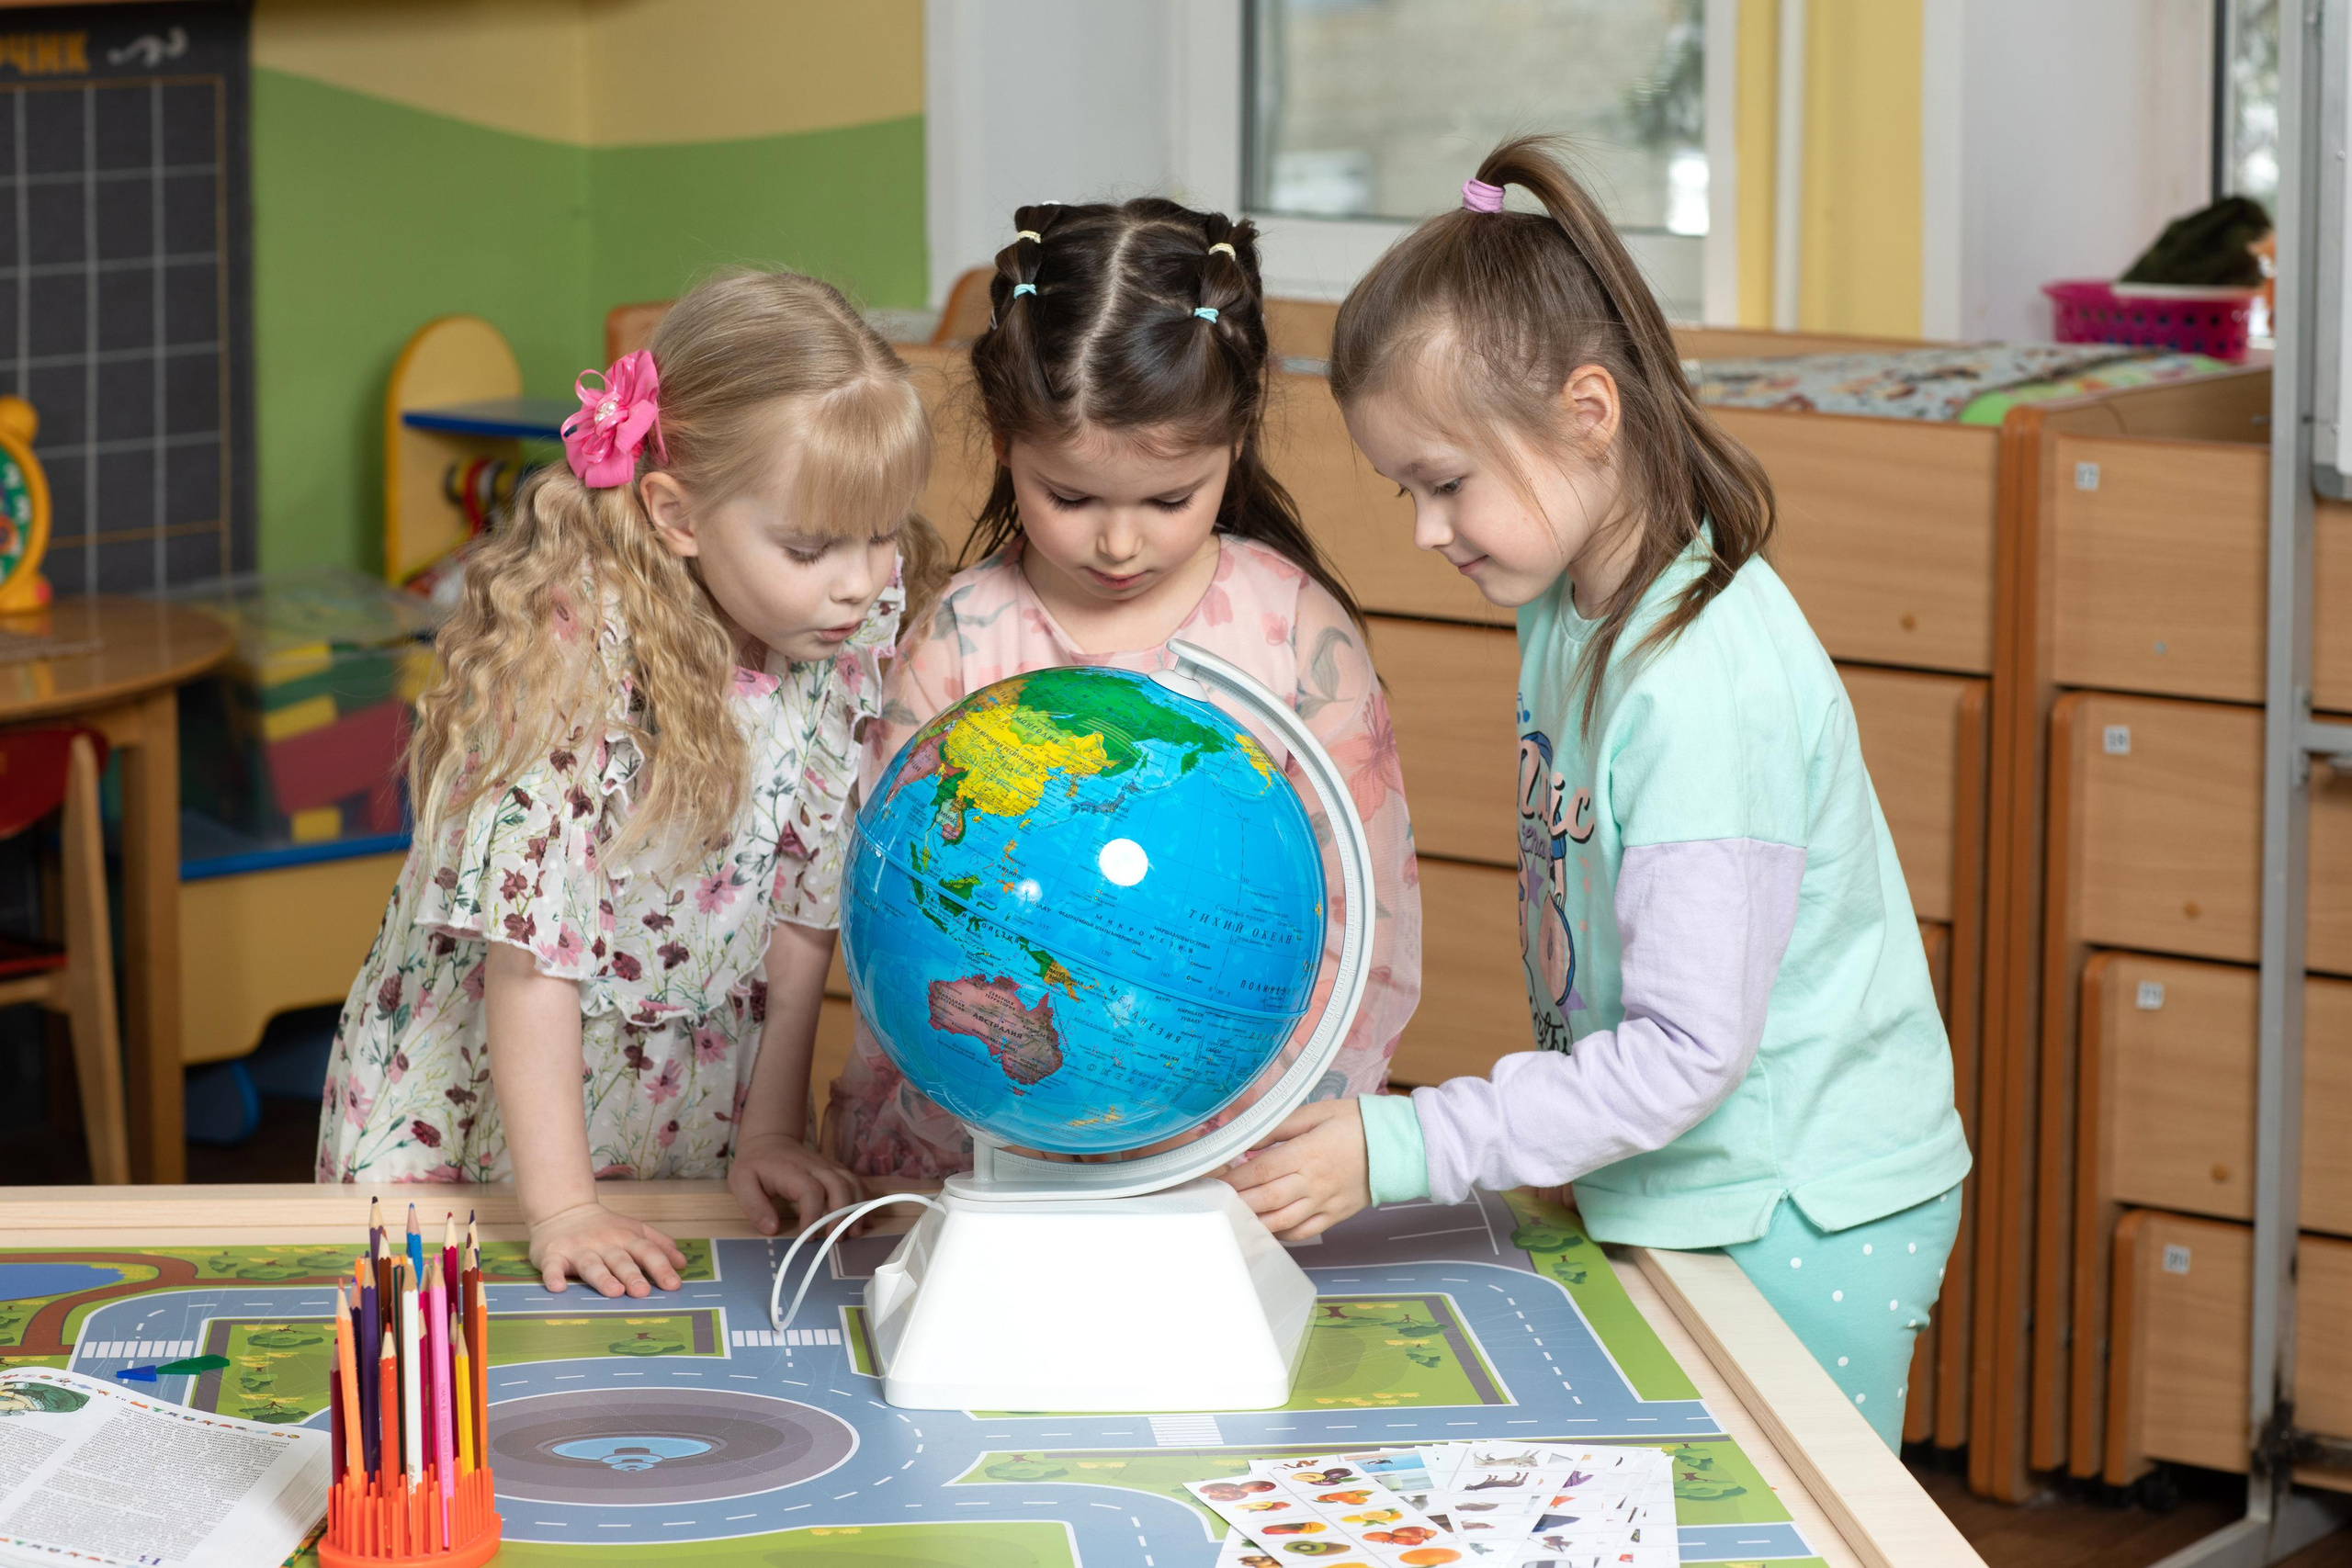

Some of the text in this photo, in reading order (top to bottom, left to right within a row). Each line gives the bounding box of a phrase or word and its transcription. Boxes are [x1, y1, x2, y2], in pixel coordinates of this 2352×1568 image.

[1015, 716, 1060, 744] МОНГОЛИЯ
[978, 730, 1002, 750] НАРОДНАЯ
[1002, 745, 1039, 770] РЕСПУБЛИКА
[1188, 908, 1293, 944] ТИХИЙ ОКЕАН
[985, 994, 1016, 1011] ТЕРРИТОРИЯ
[989, 991, 1014, 1006] СЕВЕРНАЯ
[972, 1012, 1023, 1040] АВСТРАЛИЯ
